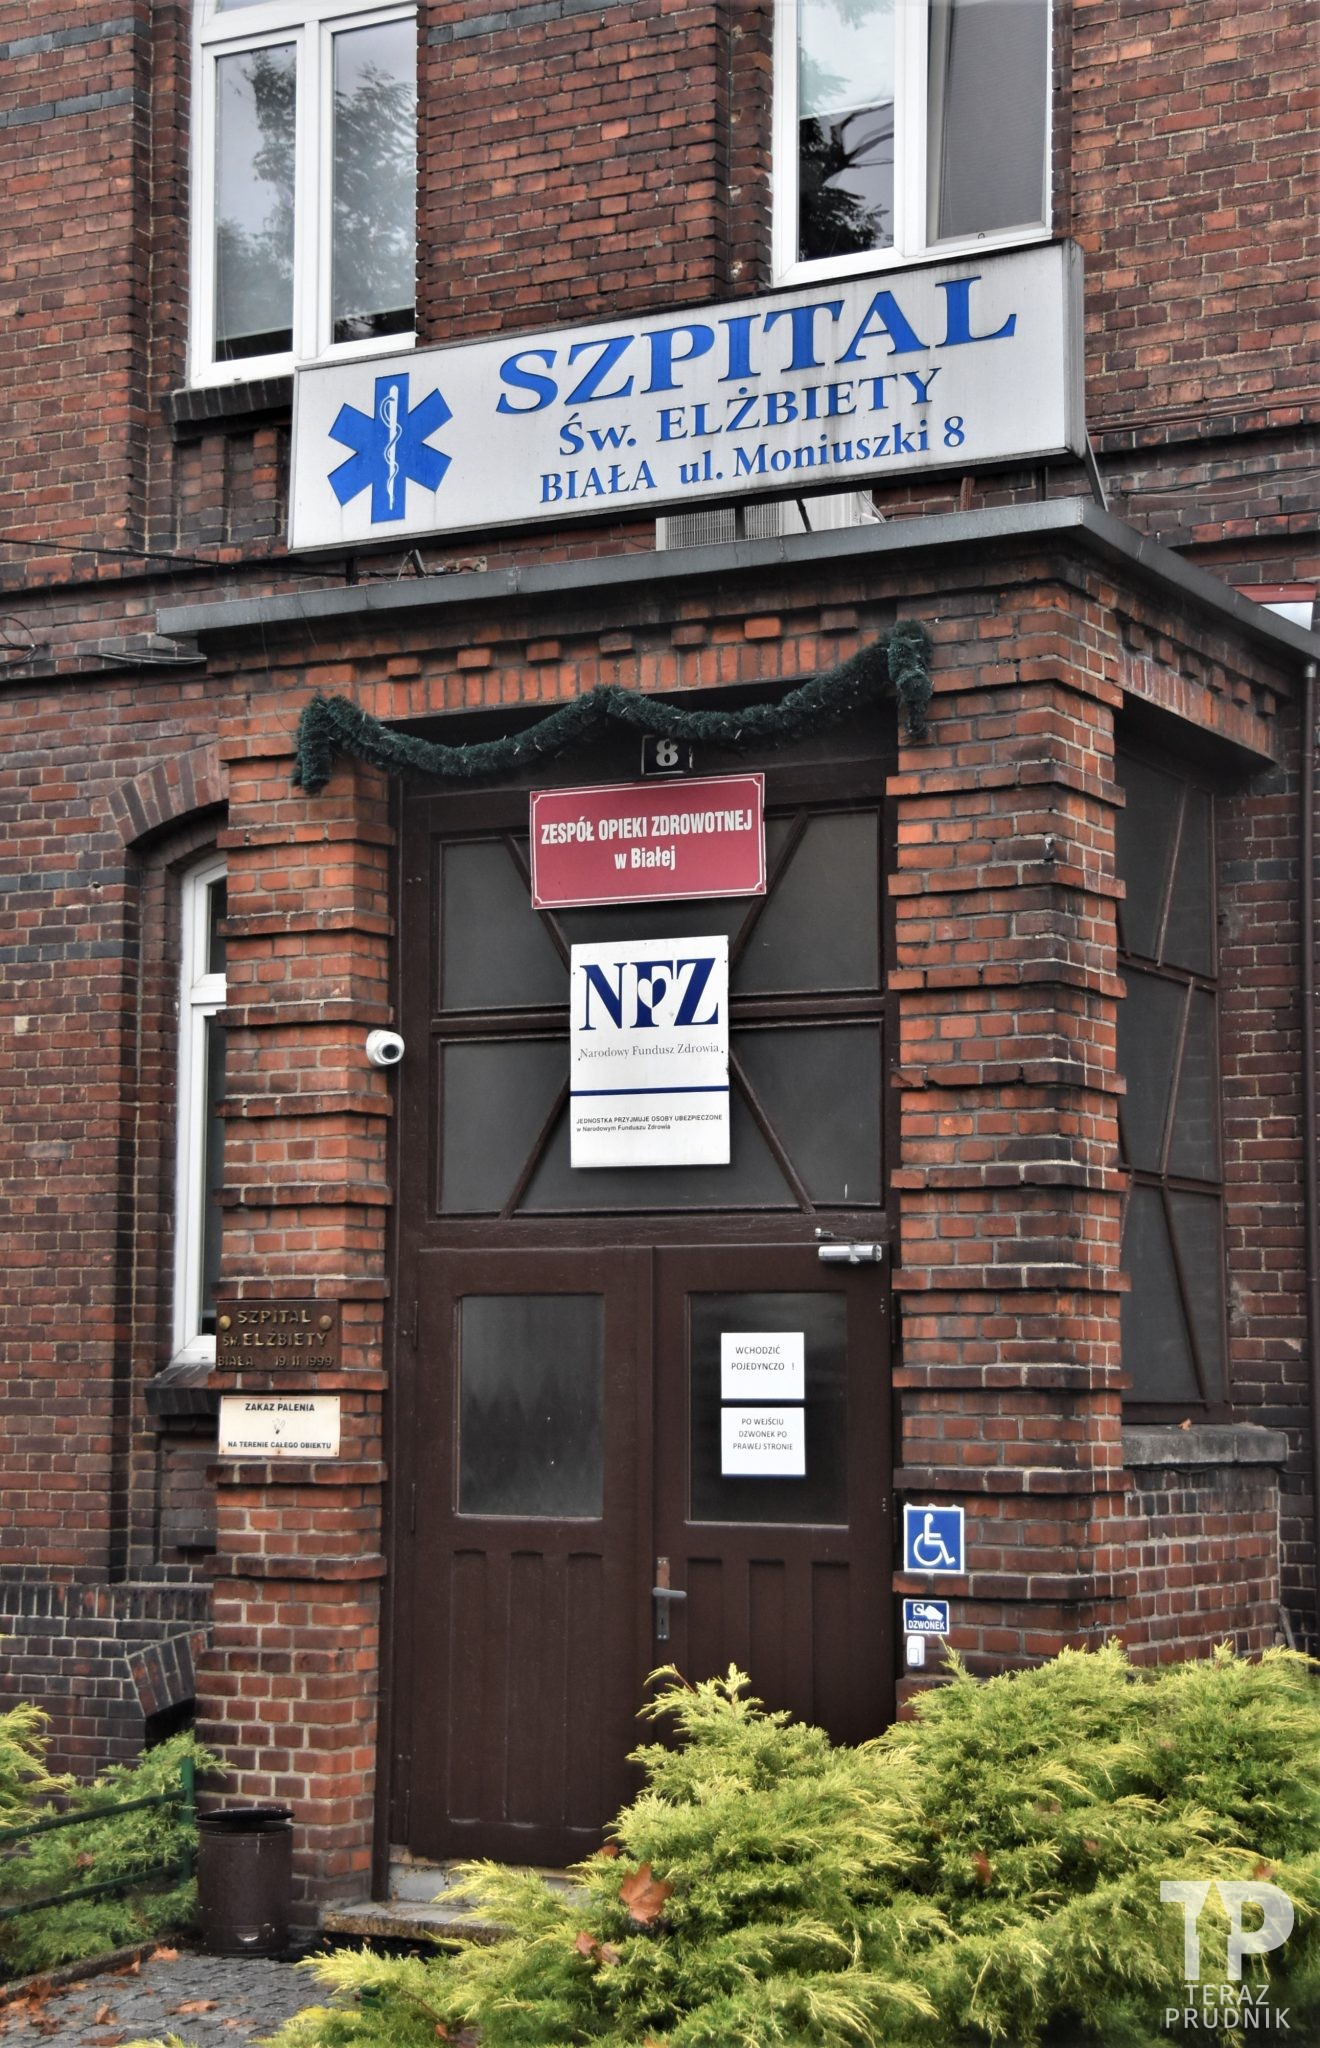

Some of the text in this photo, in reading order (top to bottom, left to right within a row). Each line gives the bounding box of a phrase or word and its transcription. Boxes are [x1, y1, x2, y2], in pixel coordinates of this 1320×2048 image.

[495, 275, 1017, 415] SZPITAL
[559, 367, 942, 456] Św. ELŻBIETY
[540, 415, 966, 503] BIAŁA ul. Moniuszki 8
[655, 738, 679, 767] 8
[541, 809, 753, 845] ZESPÓŁ OPIEKI ZDROWOTNEJ
[614, 845, 676, 871] w Białej
[579, 957, 719, 1031] NFZ
[579, 1042, 720, 1059] Narodowy Fundusz Zdrowia
[576, 1113, 723, 1125] JEDNOSTKA PRZYJMUJE OSOBY UBEZPIECZONE
[582, 1124, 617, 1132] Narodowym
[617, 1123, 647, 1131] Funduszu
[237, 1310, 312, 1324] SZPITAL
[242, 1331, 328, 1347] ELŻBIETY
[735, 1345, 781, 1354] WCHODZIĆ
[217, 1355, 254, 1367] BIAŁA
[731, 1362, 785, 1371] POJEDYNCZO
[245, 1403, 315, 1412] ZAKAZ PALENIA
[753, 1416, 784, 1425] WEJŚCIU
[270, 1441, 299, 1449] CAŁEGO
[763, 1443, 793, 1451] STRONIE
[908, 1620, 945, 1630] DZWONEK
